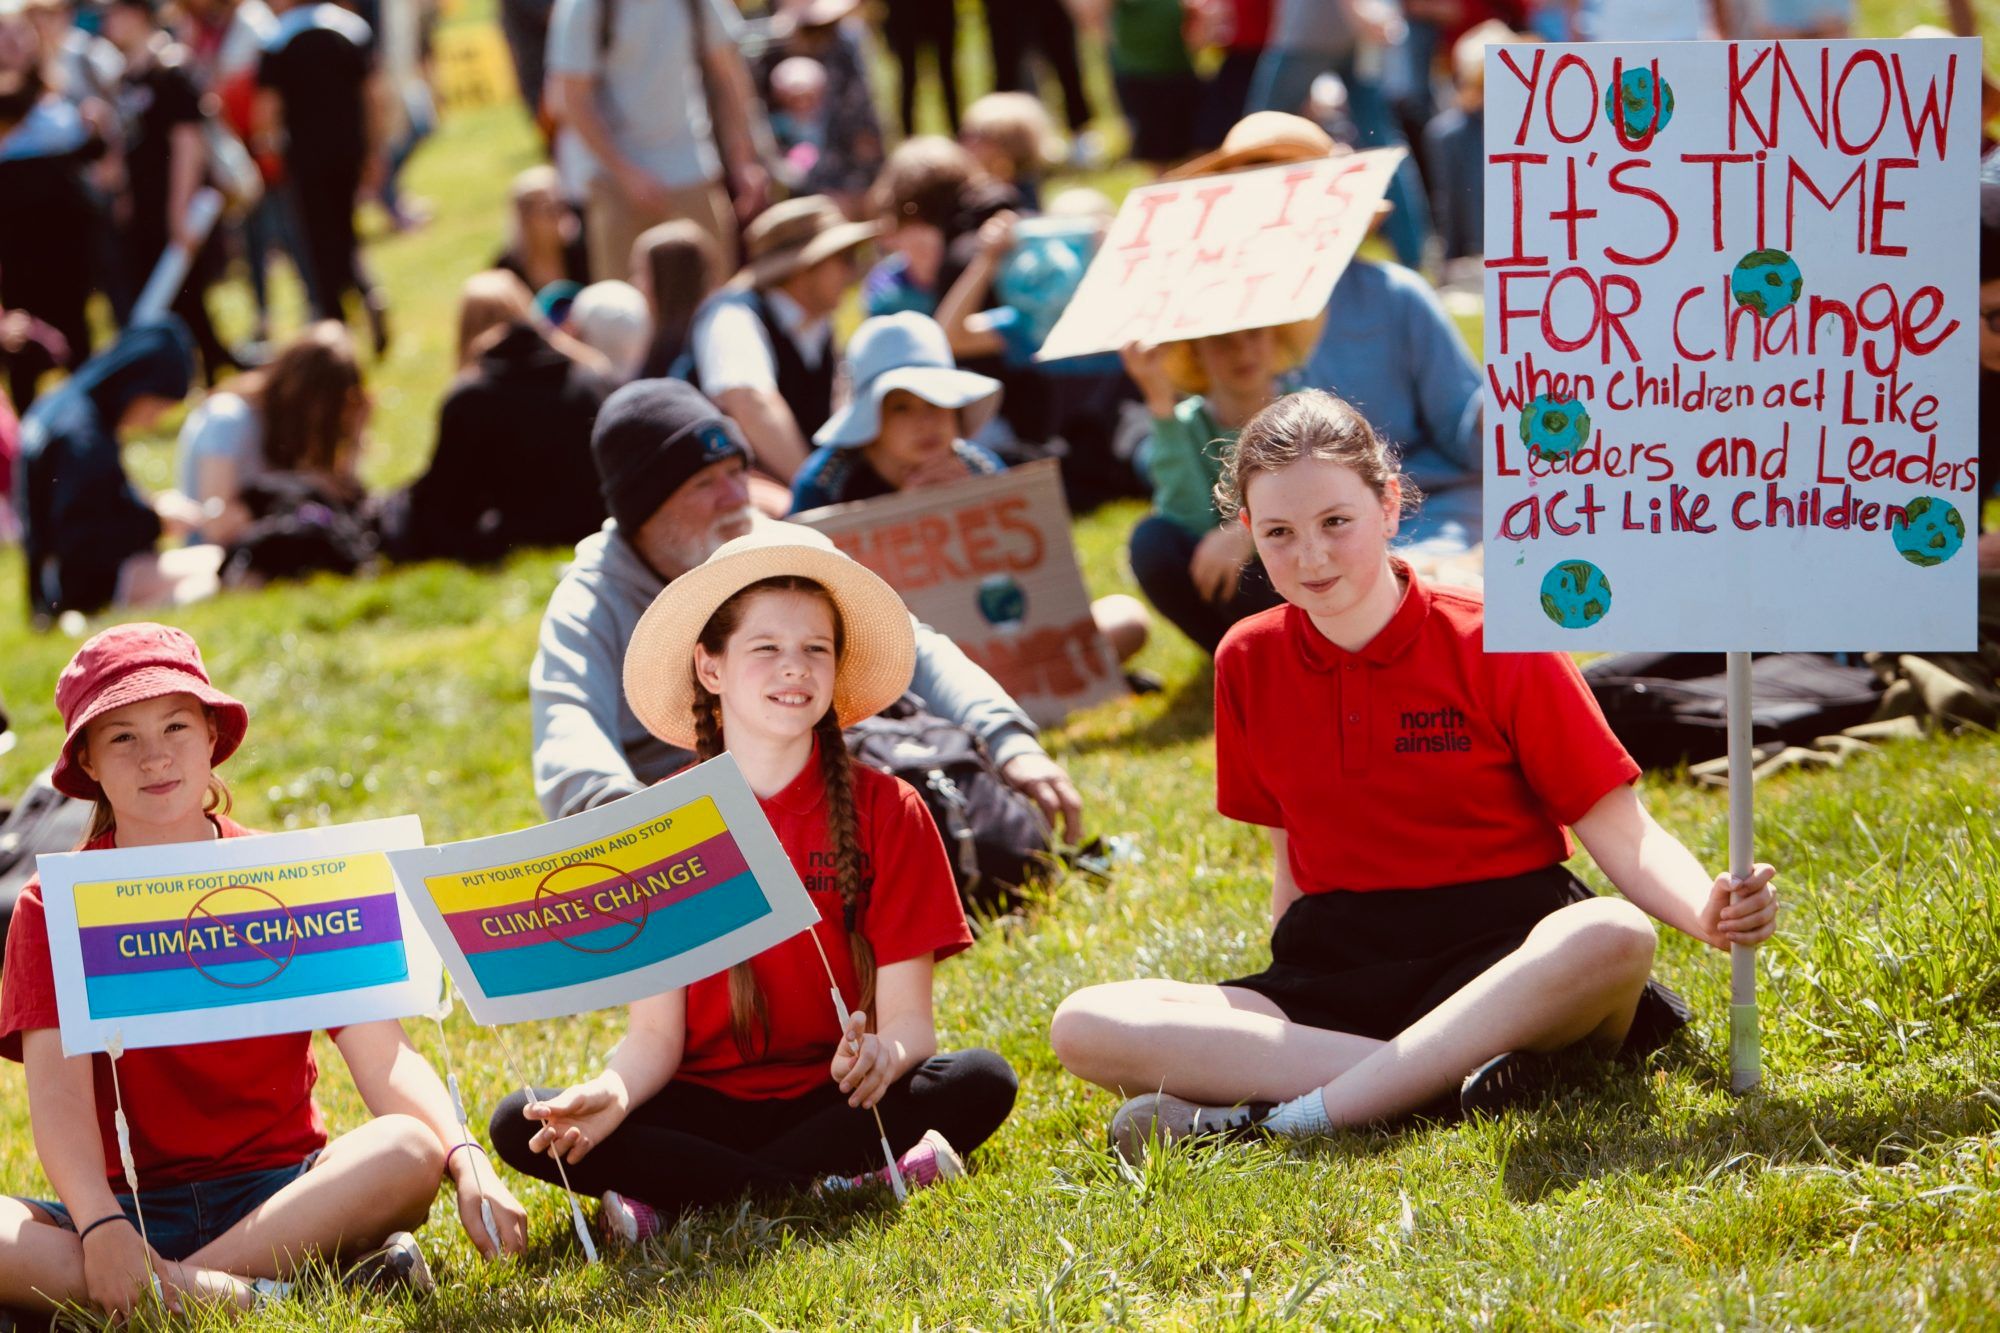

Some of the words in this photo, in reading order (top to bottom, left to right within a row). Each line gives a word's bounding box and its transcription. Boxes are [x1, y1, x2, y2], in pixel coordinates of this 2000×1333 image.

[1498, 47, 1659, 152] YOU
[1729, 40, 1958, 160] KNOW
[1498, 267, 1642, 364] FOR
[1487, 352, 1595, 412] When
[1763, 368, 1825, 412] act
[1495, 424, 1674, 481] Leaders
[1697, 421, 1789, 481] and
[1816, 425, 1979, 492] Leaders
[1395, 731, 1472, 753] ainslie
[1400, 706, 1465, 729] north
[116, 883, 142, 898] PUT
[146, 880, 184, 894] YOUR
[188, 875, 224, 891] FOOT
[228, 870, 274, 888] DOWN
[278, 866, 308, 880] AND
[311, 861, 347, 876] STOP
[462, 874, 487, 888] PUT
[488, 867, 524, 882] YOUR
[525, 859, 559, 875] FOOT
[561, 844, 607, 867] DOWN
[609, 833, 638, 852] AND
[641, 818, 674, 840] STOP
[480, 898, 591, 937] CLIMATE
[593, 855, 707, 914] CHANGE
[118, 924, 238, 958] CLIMATE
[245, 908, 362, 945] CHANGE
